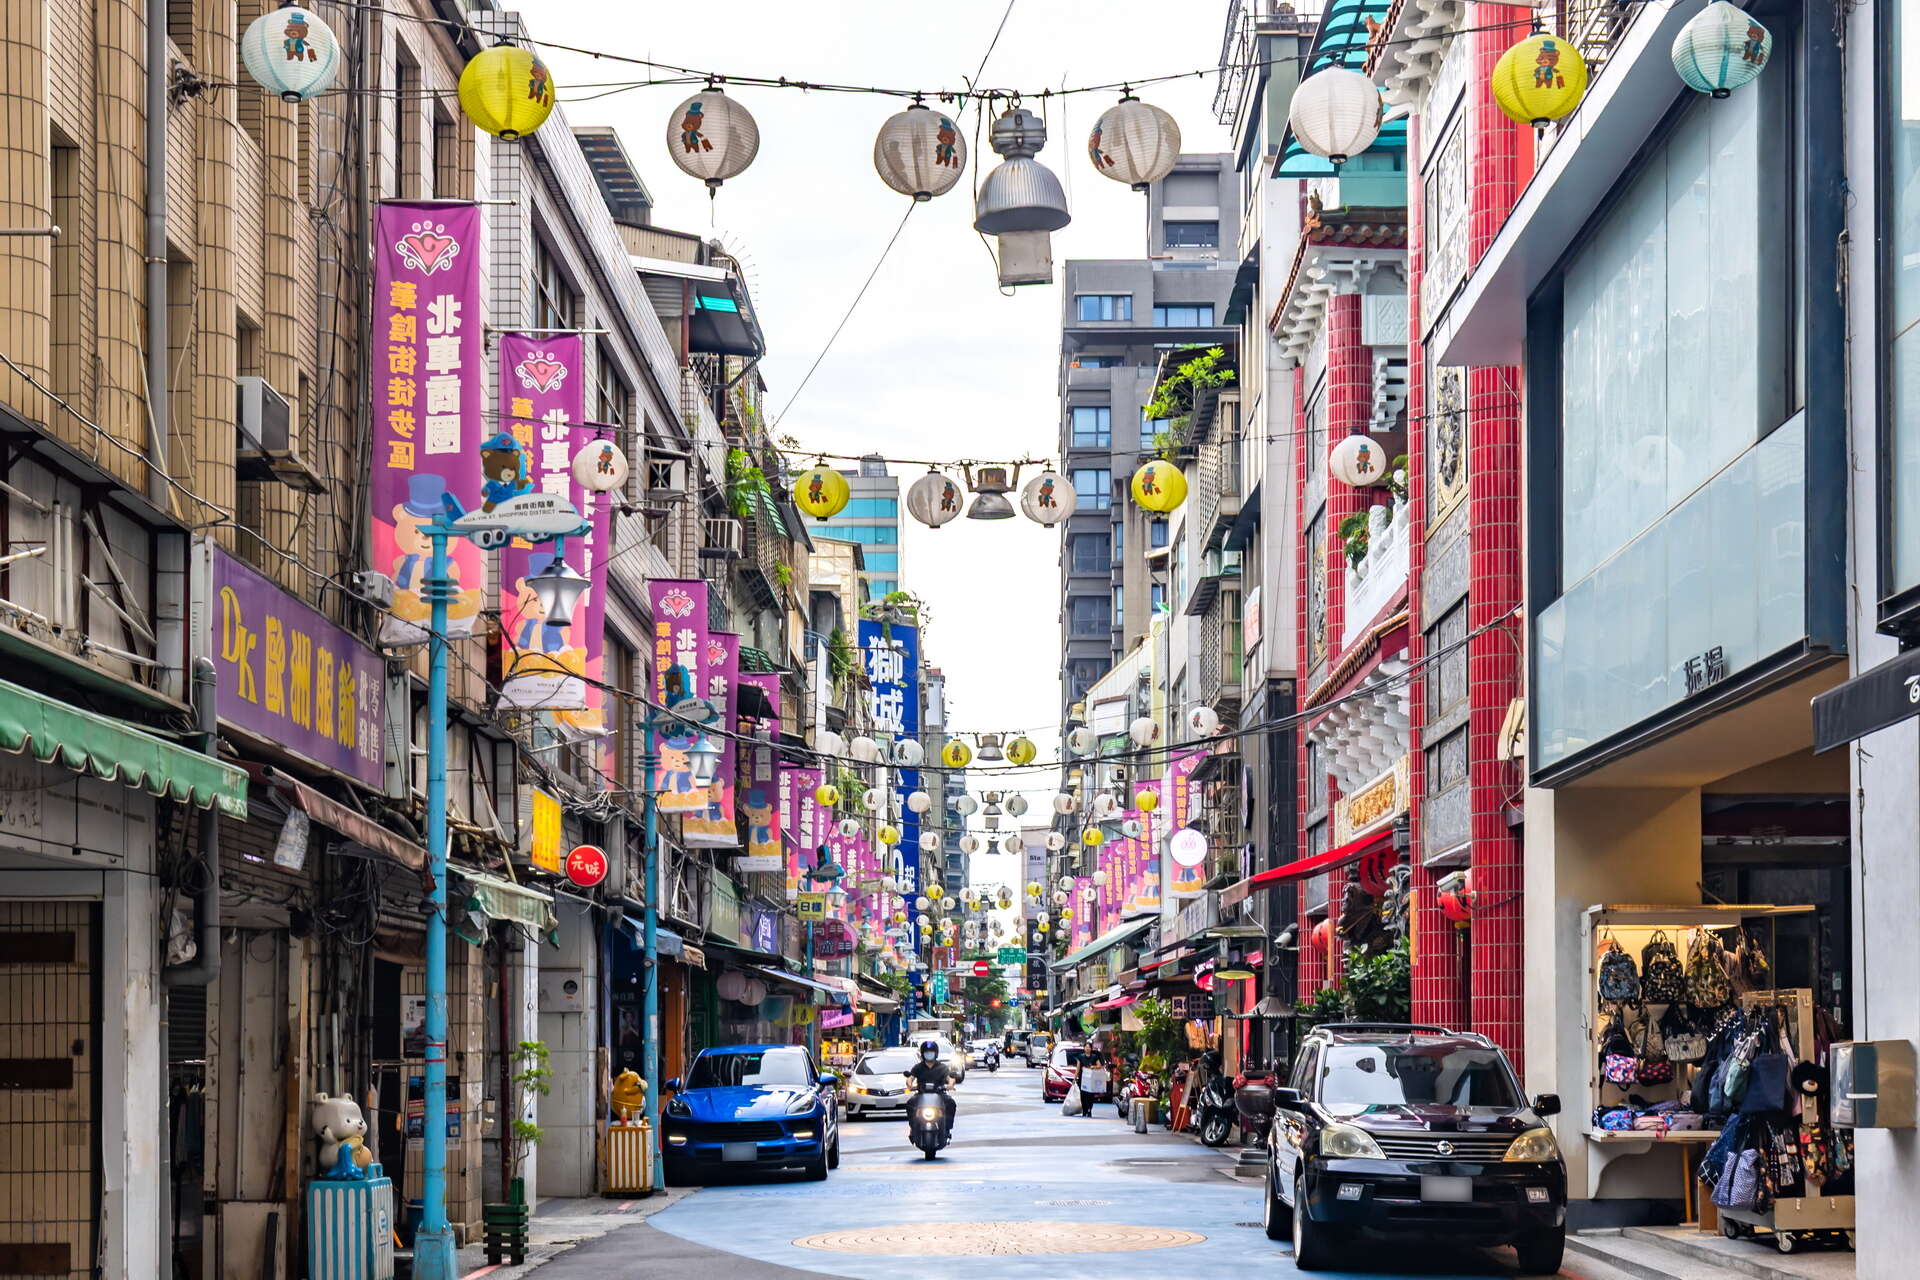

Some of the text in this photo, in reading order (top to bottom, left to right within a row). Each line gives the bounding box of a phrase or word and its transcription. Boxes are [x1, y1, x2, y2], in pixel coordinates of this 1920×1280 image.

[264, 615, 356, 750] 歐洲服飾
[571, 854, 600, 877] 元味
